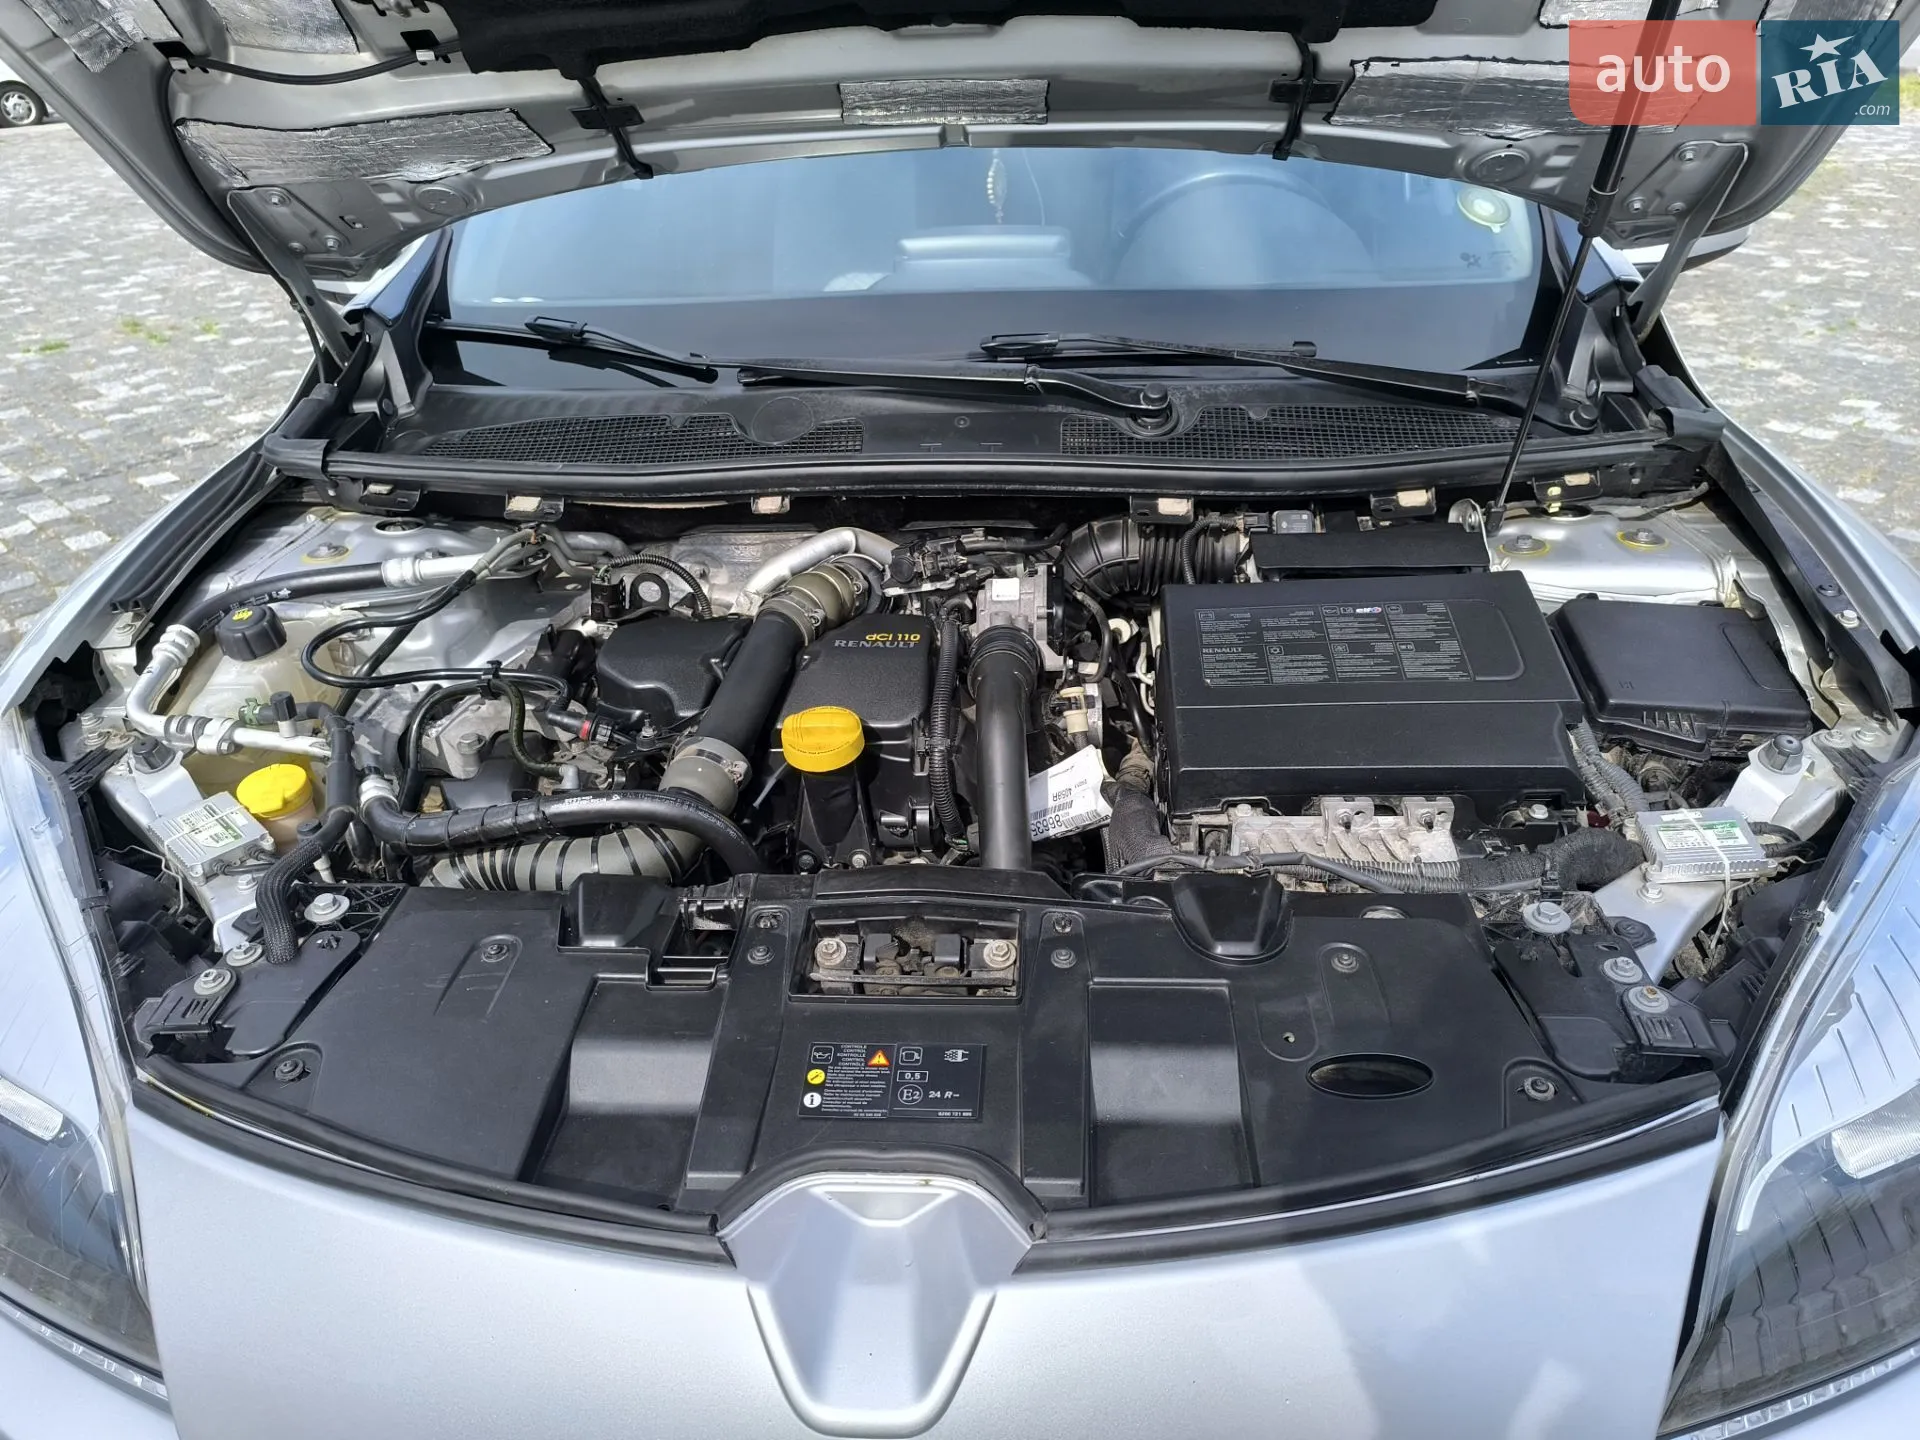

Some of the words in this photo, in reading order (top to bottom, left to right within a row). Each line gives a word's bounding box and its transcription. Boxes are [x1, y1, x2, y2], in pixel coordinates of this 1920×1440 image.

[897, 633, 921, 641] 110
[834, 639, 919, 649] RENAULT
[1202, 646, 1243, 654] RENAULT
[904, 1072, 921, 1081] 0,5
[902, 1088, 920, 1101] E2
[928, 1090, 941, 1098] 24
